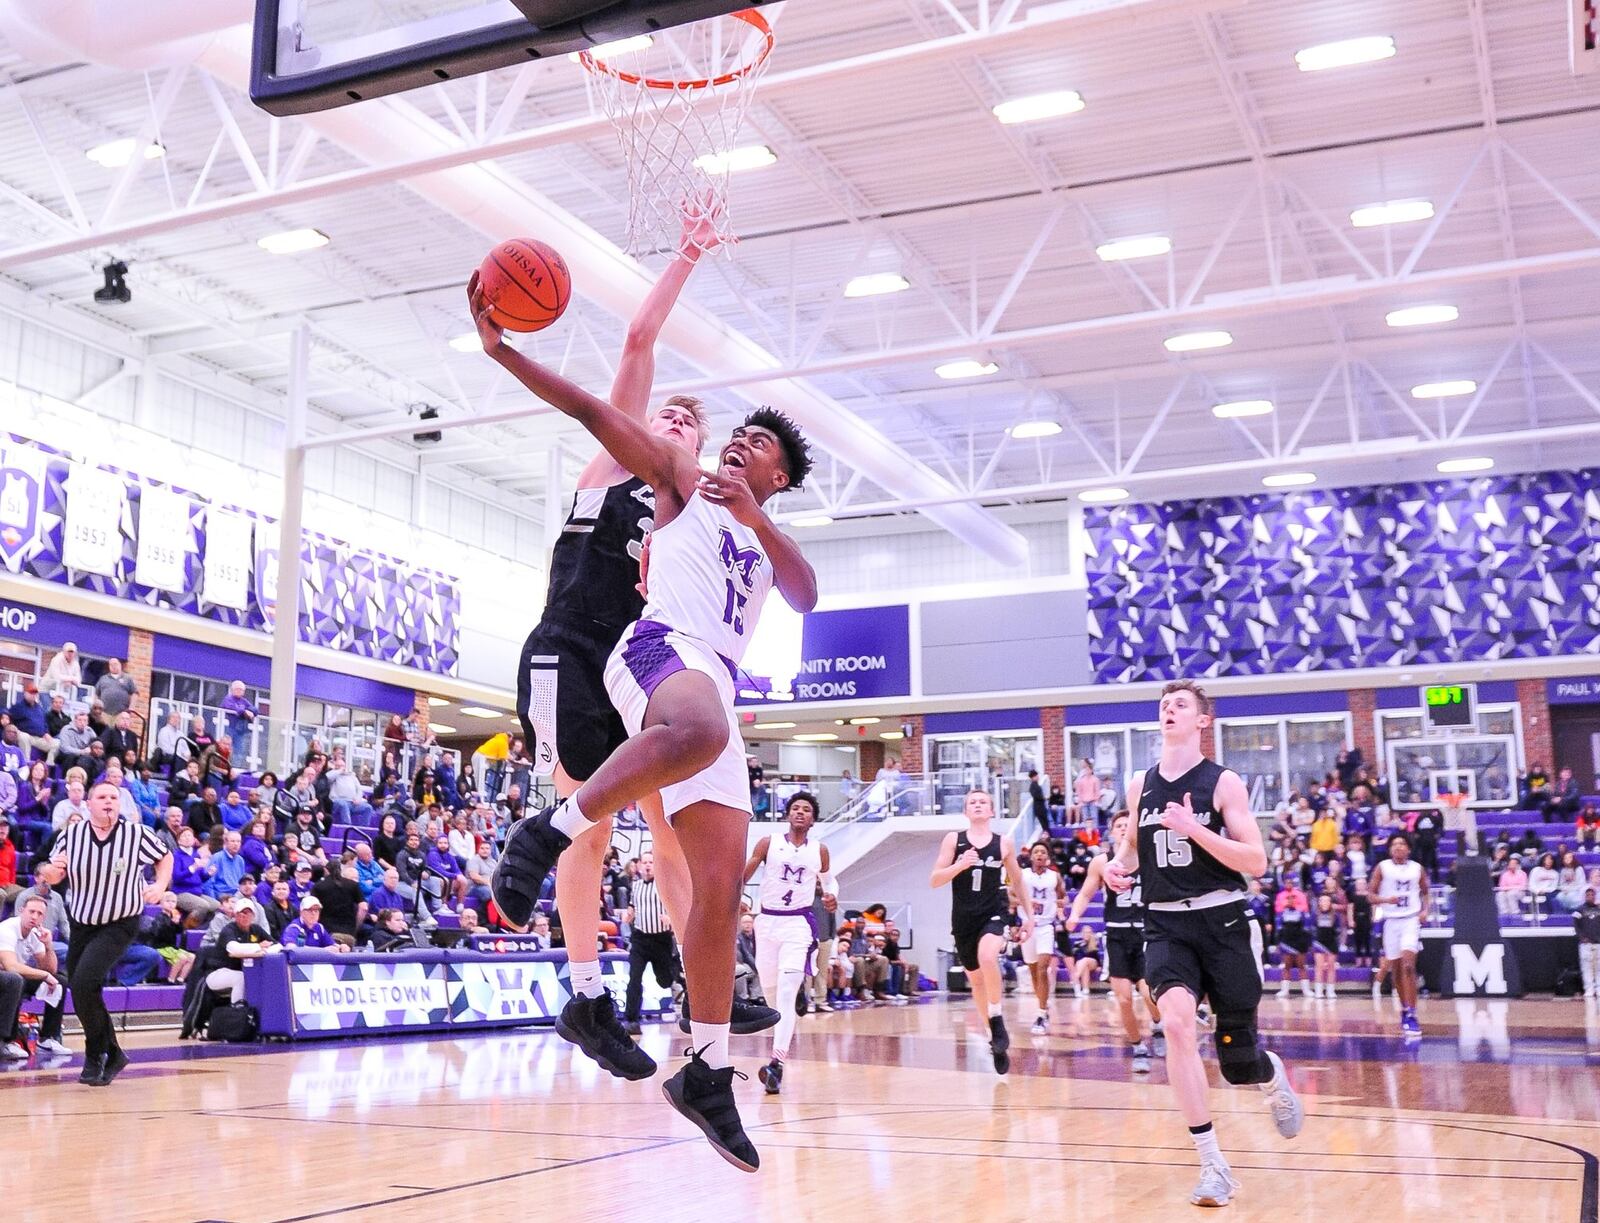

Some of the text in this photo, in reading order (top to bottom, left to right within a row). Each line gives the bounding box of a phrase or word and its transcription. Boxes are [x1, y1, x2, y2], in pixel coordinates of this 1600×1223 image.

[503, 245, 543, 288] OHSAA
[718, 524, 764, 593] M
[723, 578, 748, 636] 15
[835, 656, 886, 672] ROOM
[1557, 683, 1591, 696] PAUL
[1153, 829, 1193, 868] 15
[780, 864, 805, 884] M
[972, 869, 982, 891] 1
[782, 889, 794, 906] 4
[1032, 886, 1046, 899] M
[1450, 943, 1508, 994] M
[309, 985, 432, 1006] MIDDLETOWN
